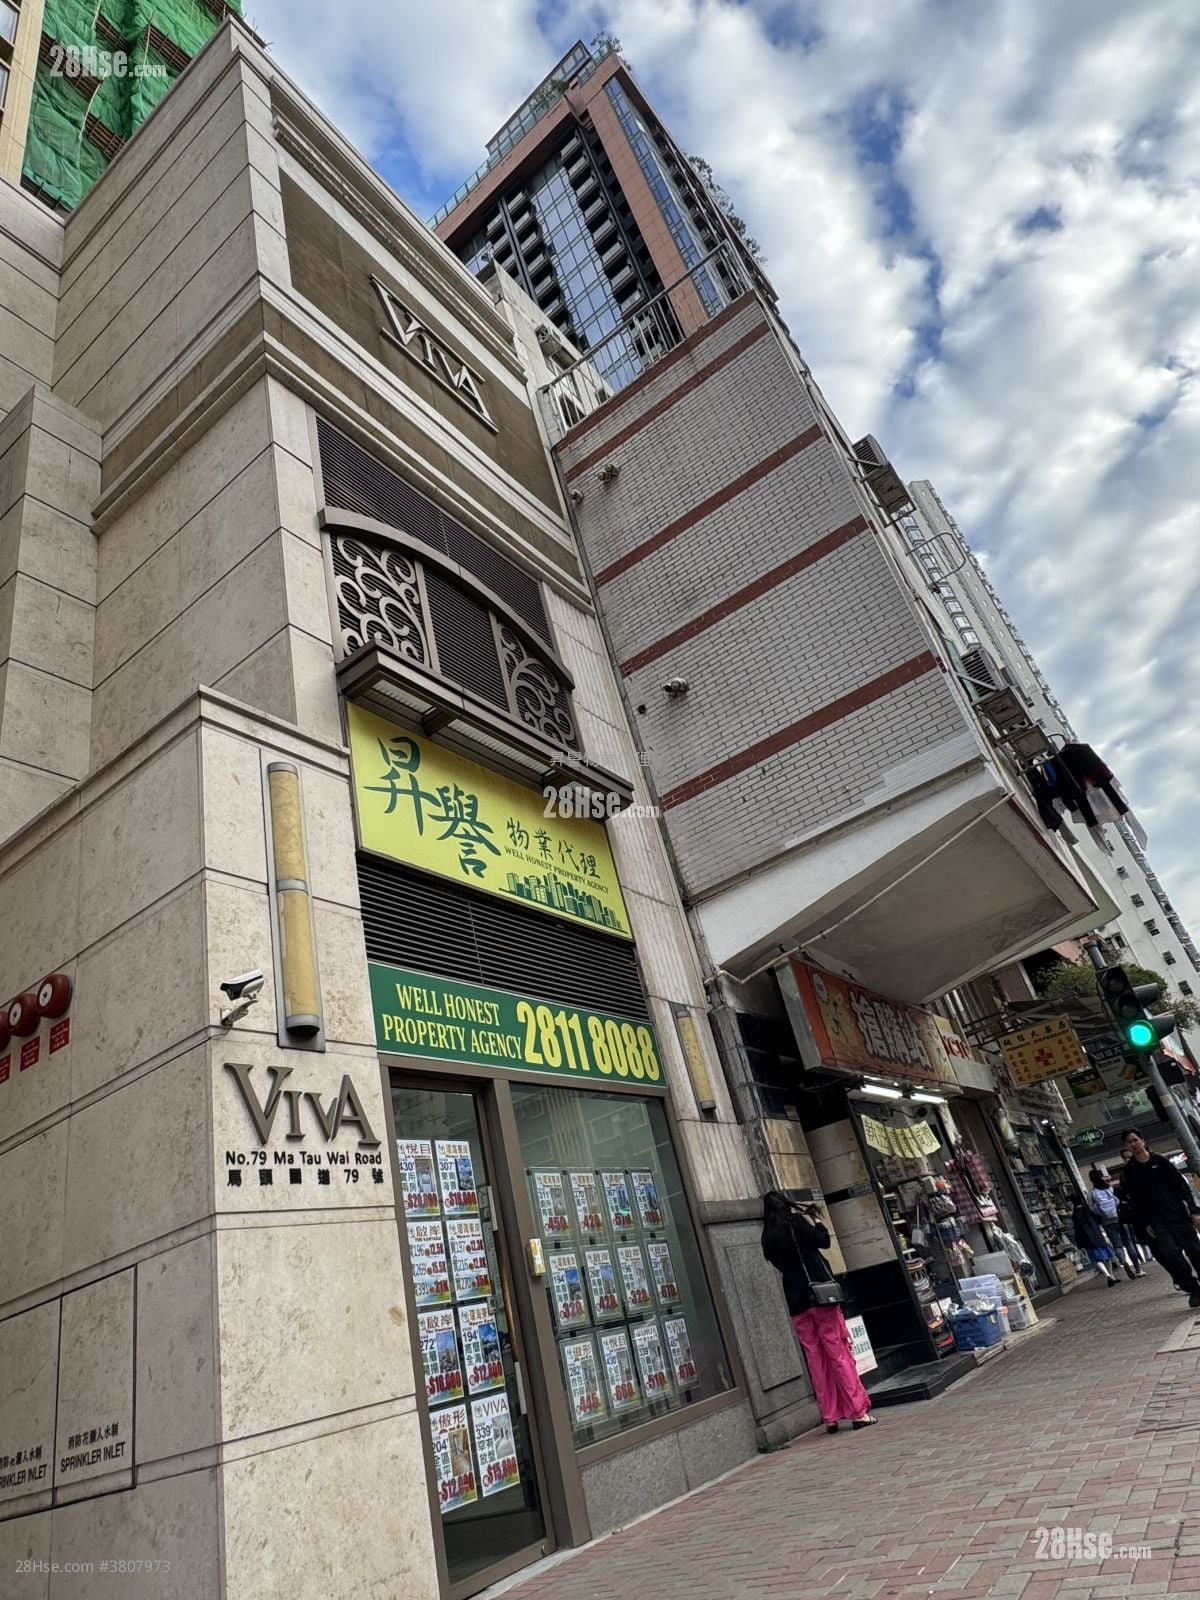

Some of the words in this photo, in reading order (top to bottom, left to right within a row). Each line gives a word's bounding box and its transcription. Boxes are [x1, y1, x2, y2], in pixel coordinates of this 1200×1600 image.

[369, 277, 497, 427] VIVA
[504, 845, 525, 860] WELL
[526, 854, 552, 871] HONEST
[553, 865, 586, 885] PROPERTY
[587, 879, 609, 894] AGENCY
[506, 816, 600, 879] 物業代理
[395, 983, 442, 1016] WELL
[443, 993, 500, 1026] HONEST
[382, 1013, 466, 1051] PROPERTY
[471, 1029, 523, 1060] AGENCY
[516, 1000, 590, 1071] 2811
[587, 1015, 660, 1081] 8088
[223, 1063, 381, 1147] VIVA
[225, 1151, 267, 1165] No.79
[274, 1151, 294, 1165] Ma
[300, 1151, 321, 1165] Tau
[327, 1151, 349, 1165] Wai
[355, 1152, 382, 1165] Road
[482, 1398, 508, 1417] VIVA
[27, 1463, 48, 1482] INLET
[60, 1447, 102, 1473] SPRINKLER
[103, 1441, 126, 1462] INLET
